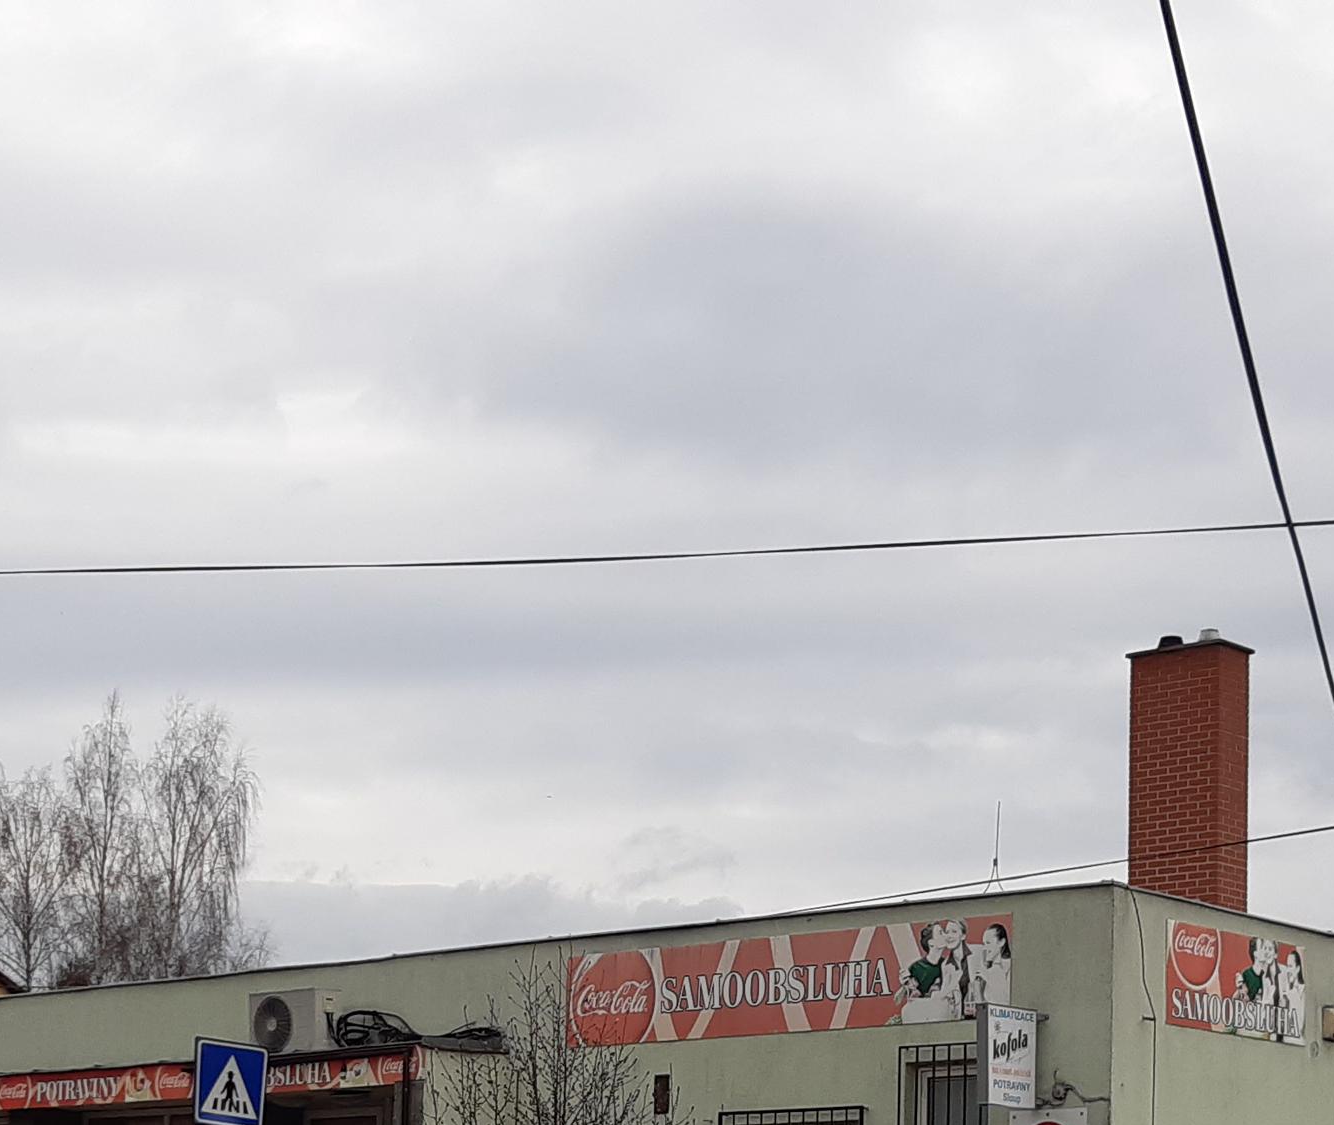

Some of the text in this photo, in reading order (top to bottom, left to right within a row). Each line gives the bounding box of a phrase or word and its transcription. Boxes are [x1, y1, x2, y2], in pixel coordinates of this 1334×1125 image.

[660, 958, 892, 1014] SAMOOBSLUHA
[989, 1007, 1035, 1022] KLIMATIZACE
[1172, 988, 1300, 1038] SAMOOBSLUHA
[993, 1029, 1028, 1062] kofola
[36, 1076, 120, 1102] POTRAVINY
[993, 1079, 1031, 1092] POTRAVINY
